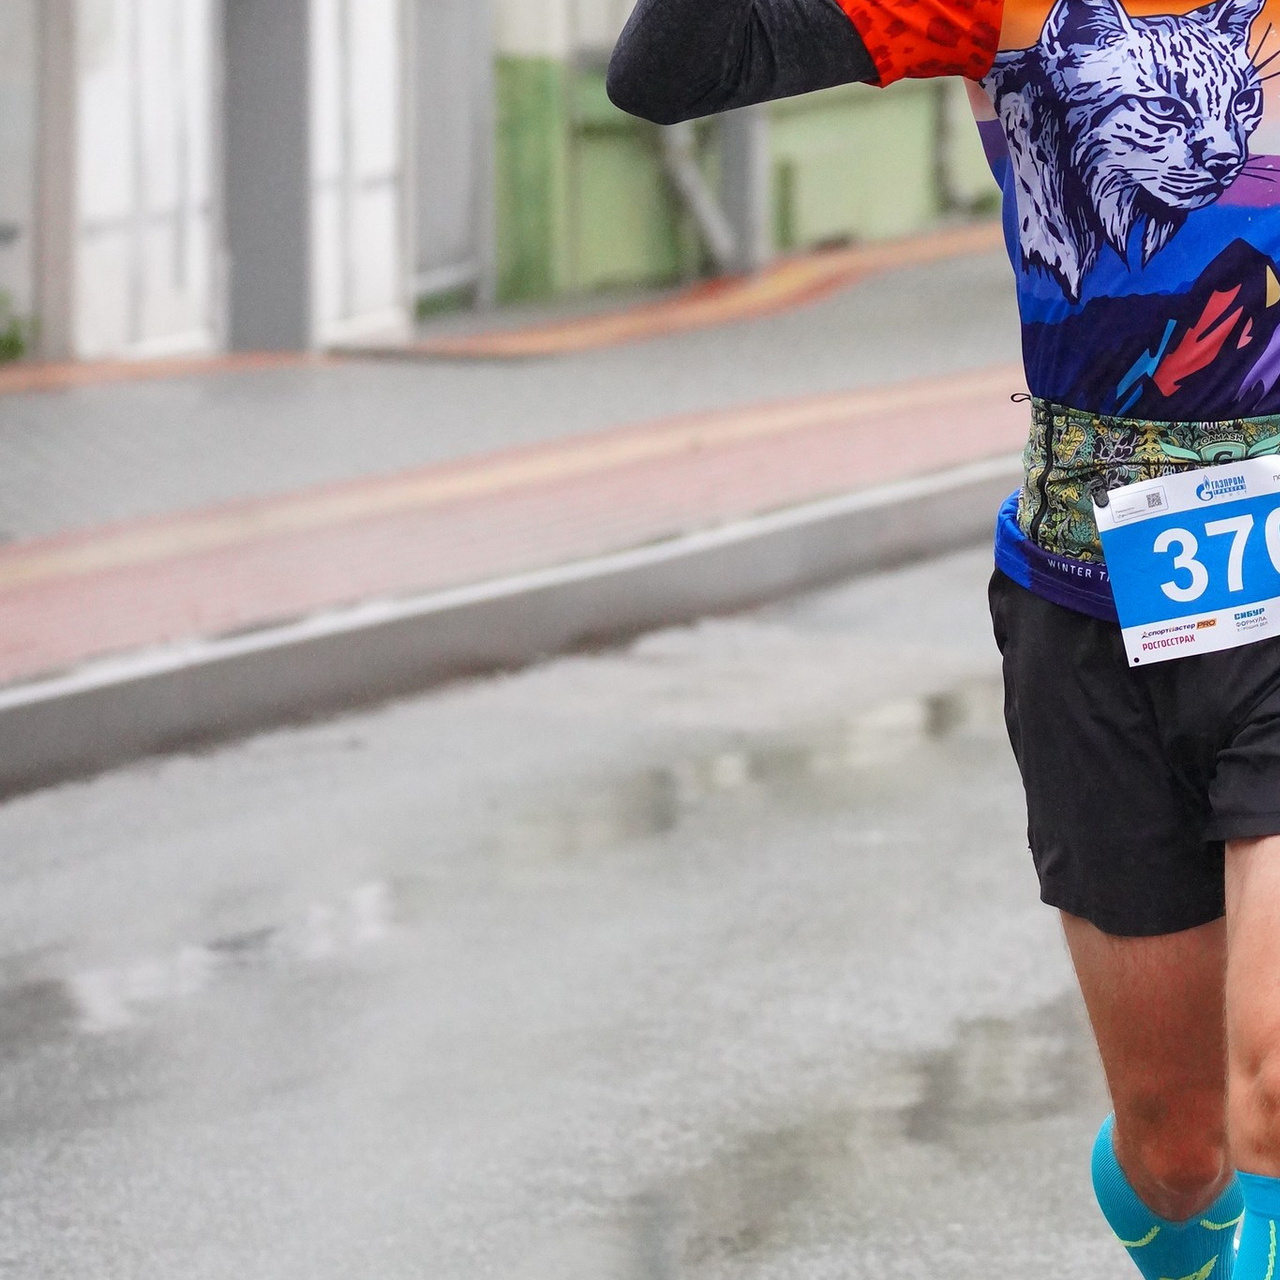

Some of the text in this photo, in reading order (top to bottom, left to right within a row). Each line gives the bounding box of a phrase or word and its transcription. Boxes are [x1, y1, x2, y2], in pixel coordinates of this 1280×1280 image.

[1200, 432, 1244, 444] GAMASH
[1211, 475, 1246, 490] ГАЗПРОМ
[1047, 559, 1092, 578] WINTER
[1234, 607, 1265, 620] СИБУР
[1197, 619, 1217, 629] PRO
[1235, 616, 1267, 627] ФОРМУЛА
[1142, 634, 1196, 651] РОСГОССТРАХ
